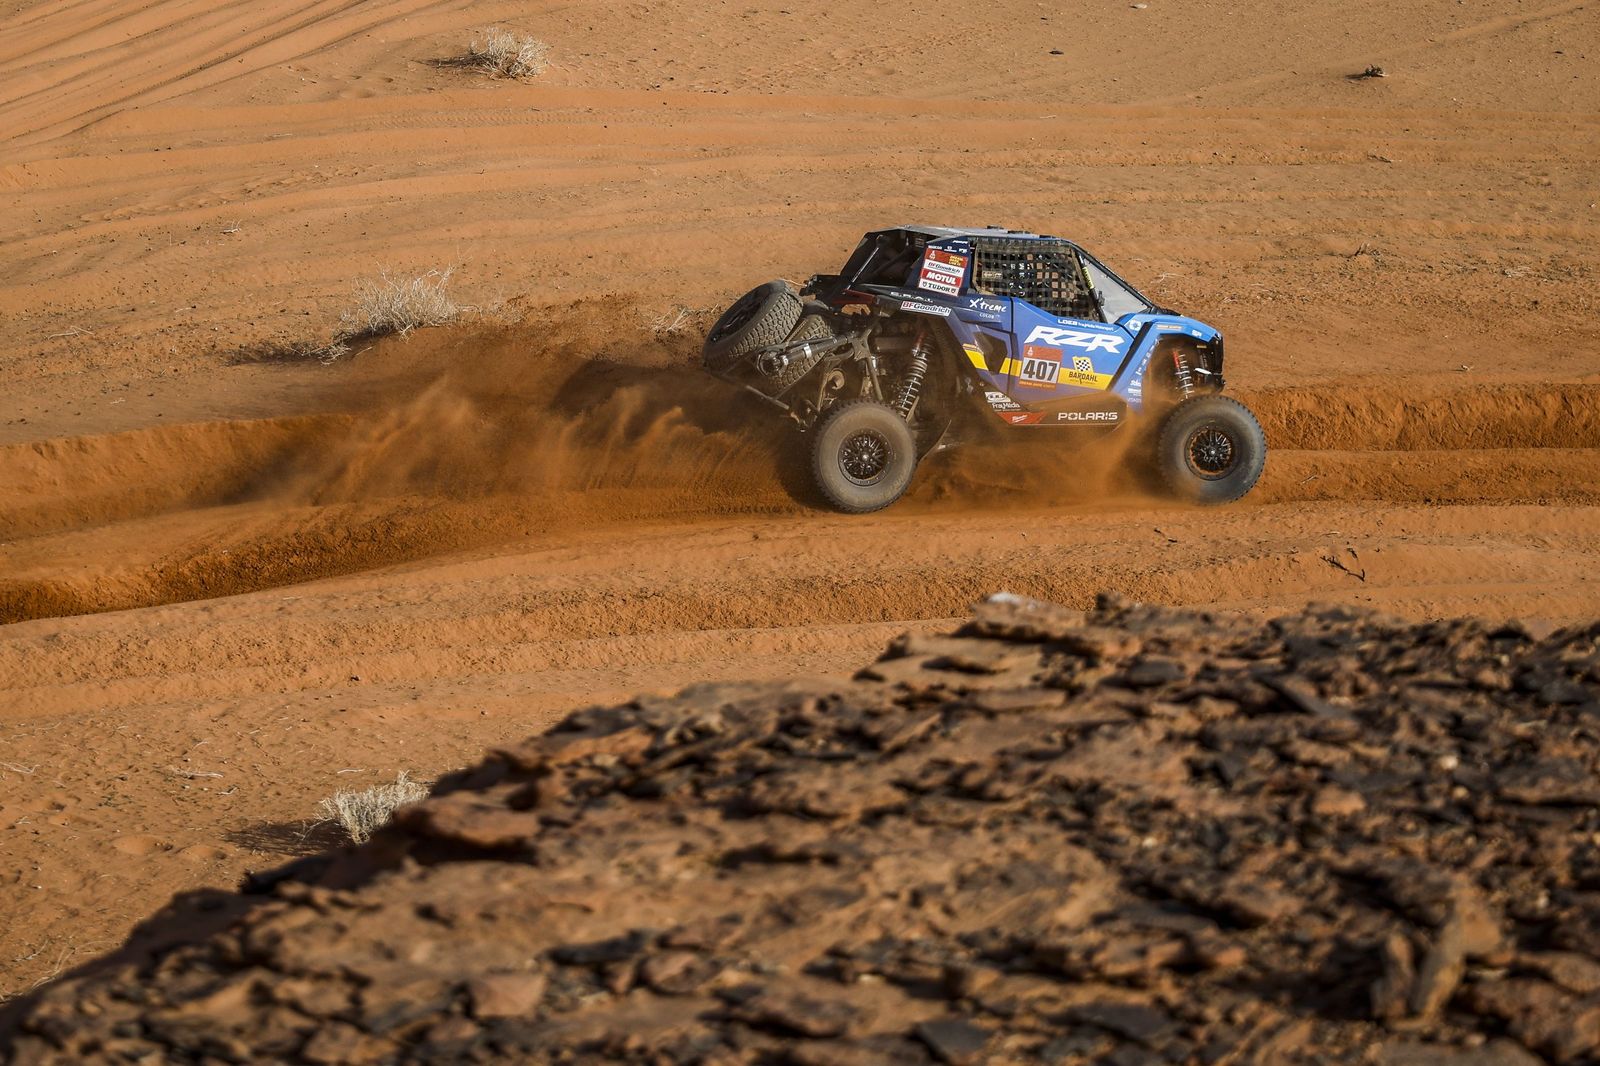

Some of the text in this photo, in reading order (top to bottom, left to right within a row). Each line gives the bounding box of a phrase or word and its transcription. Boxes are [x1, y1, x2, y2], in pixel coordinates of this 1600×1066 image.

[928, 261, 961, 273] BFGoodrich
[926, 271, 956, 285] MOTUL
[928, 281, 951, 293] TUDOR
[902, 301, 951, 314] BFGoodrich
[1024, 325, 1125, 353] RZR
[1023, 360, 1057, 381] 407
[1068, 371, 1098, 382] BARDAHL
[1057, 412, 1118, 421] POLARIS
